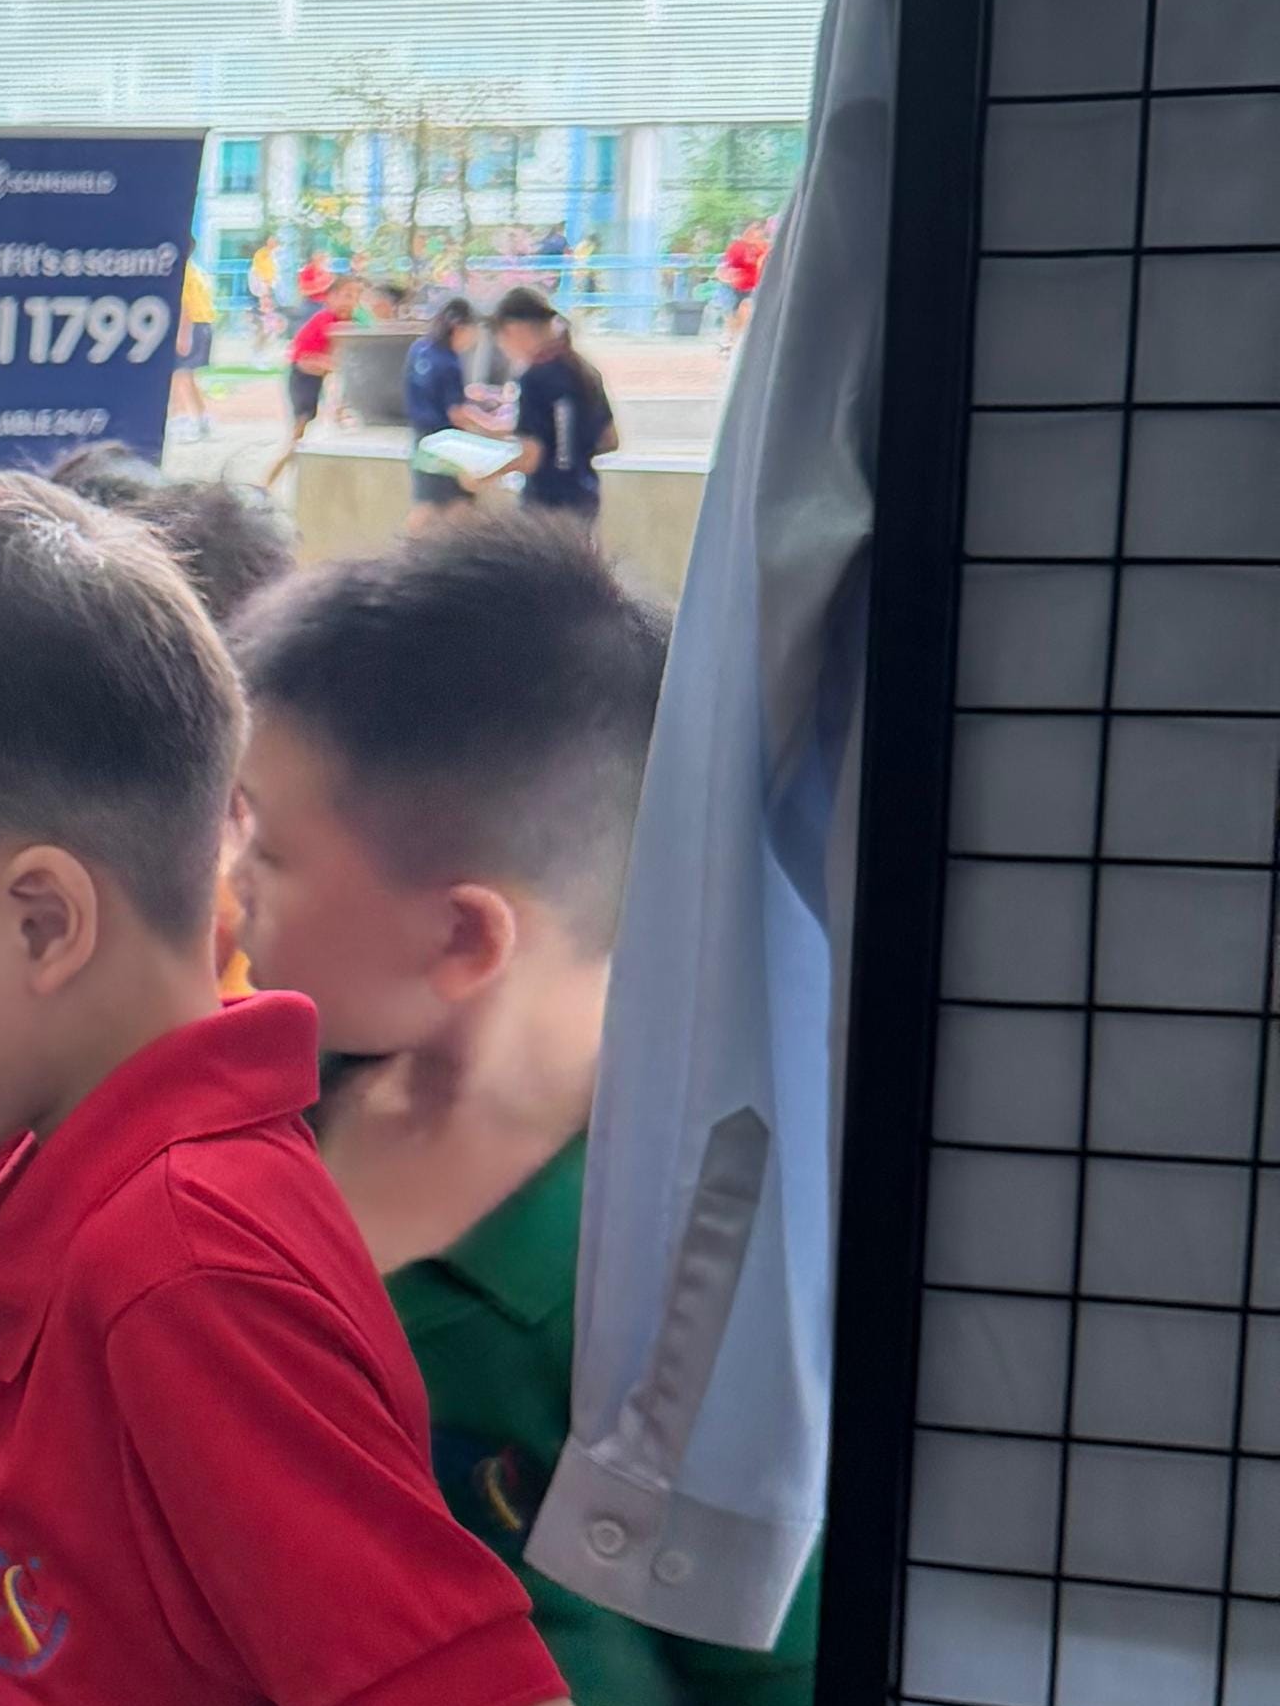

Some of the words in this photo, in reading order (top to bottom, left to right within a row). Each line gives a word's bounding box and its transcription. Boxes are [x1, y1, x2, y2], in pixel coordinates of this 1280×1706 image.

[62, 249, 82, 277] a
[83, 242, 179, 277] scam?
[23, 295, 171, 364] 1799
